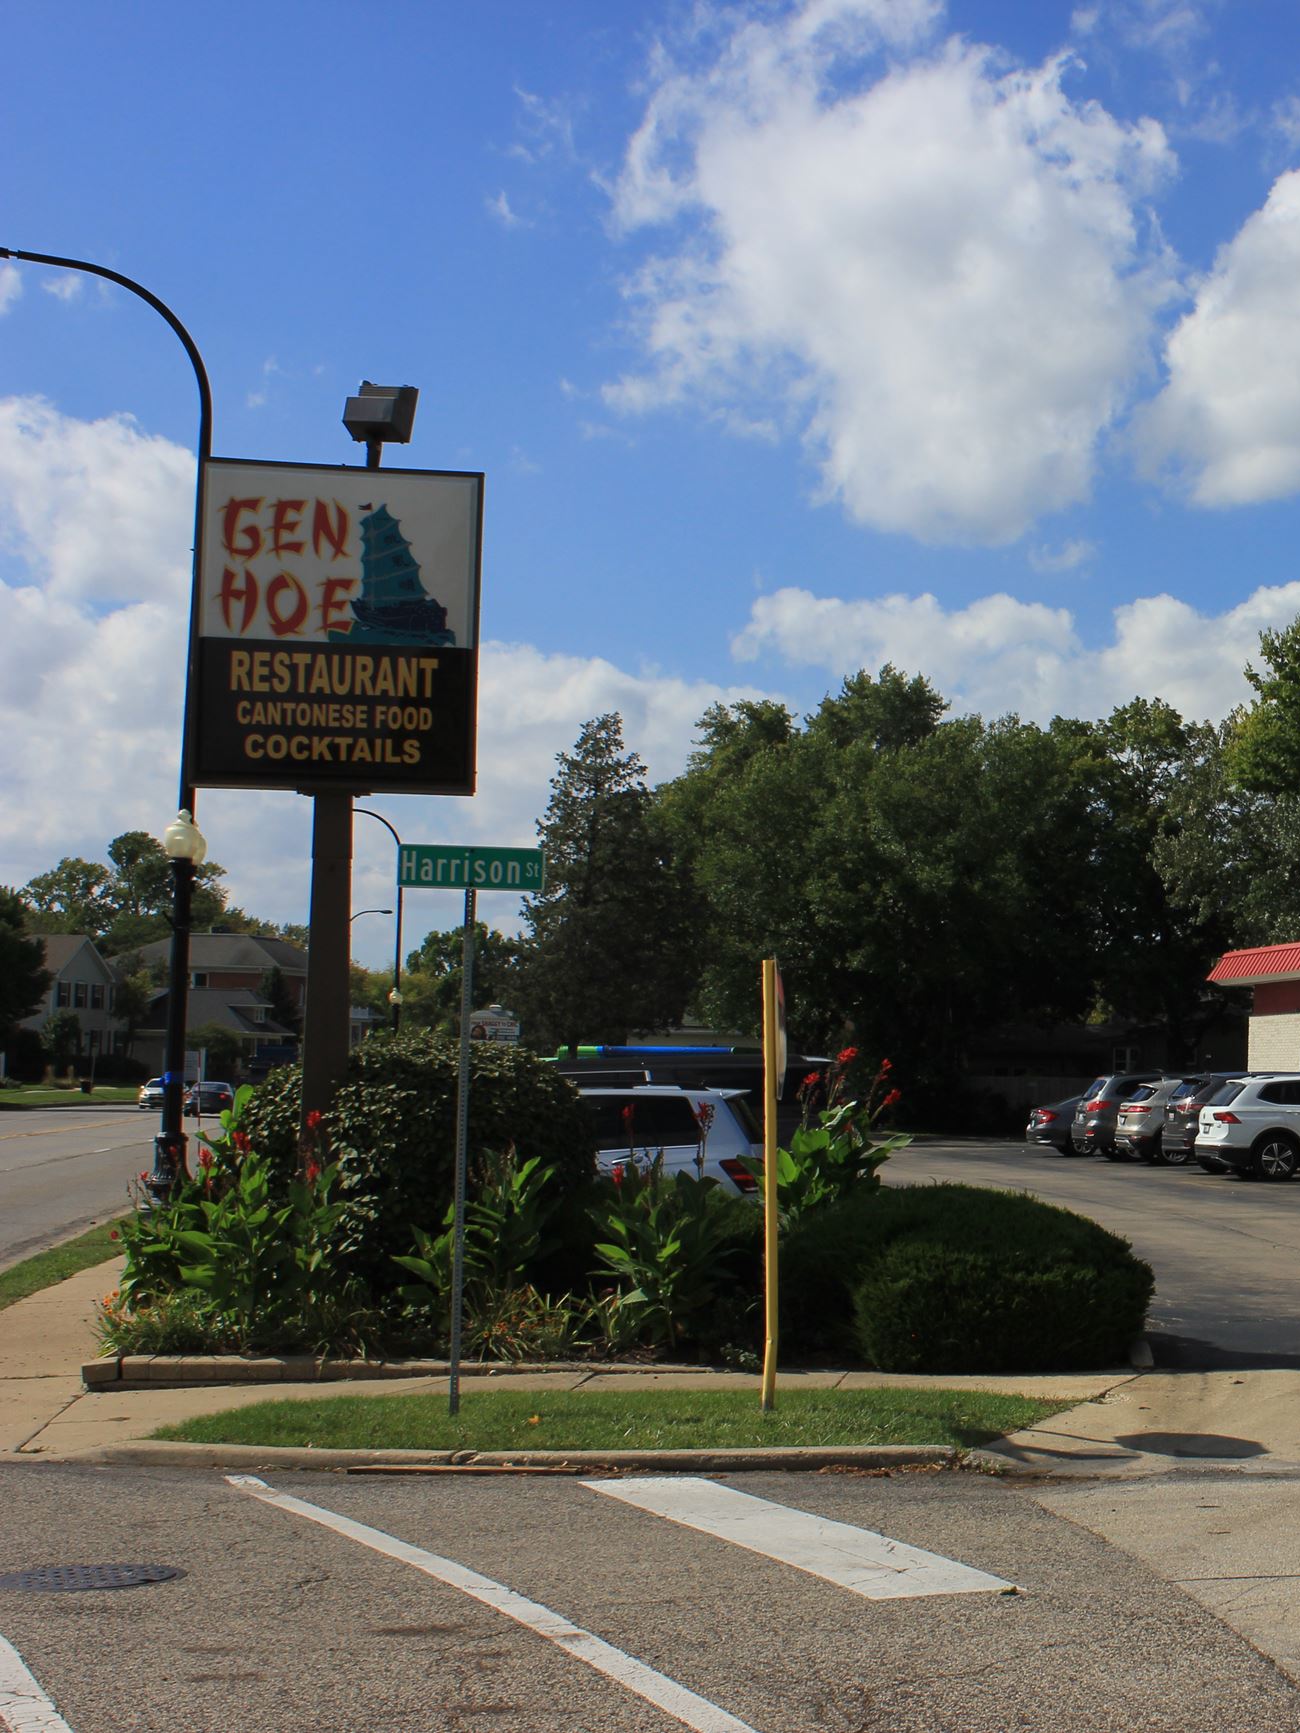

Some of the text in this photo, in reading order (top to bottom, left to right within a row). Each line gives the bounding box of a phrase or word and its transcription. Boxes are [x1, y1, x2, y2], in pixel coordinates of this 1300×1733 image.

[218, 496, 352, 561] GEN
[214, 564, 358, 638] HOE
[231, 650, 439, 698] RESTAURANT
[237, 700, 433, 731] CANTONESE FOOD
[244, 733, 421, 764] COCKTAILS
[402, 850, 540, 884] Harrison St
